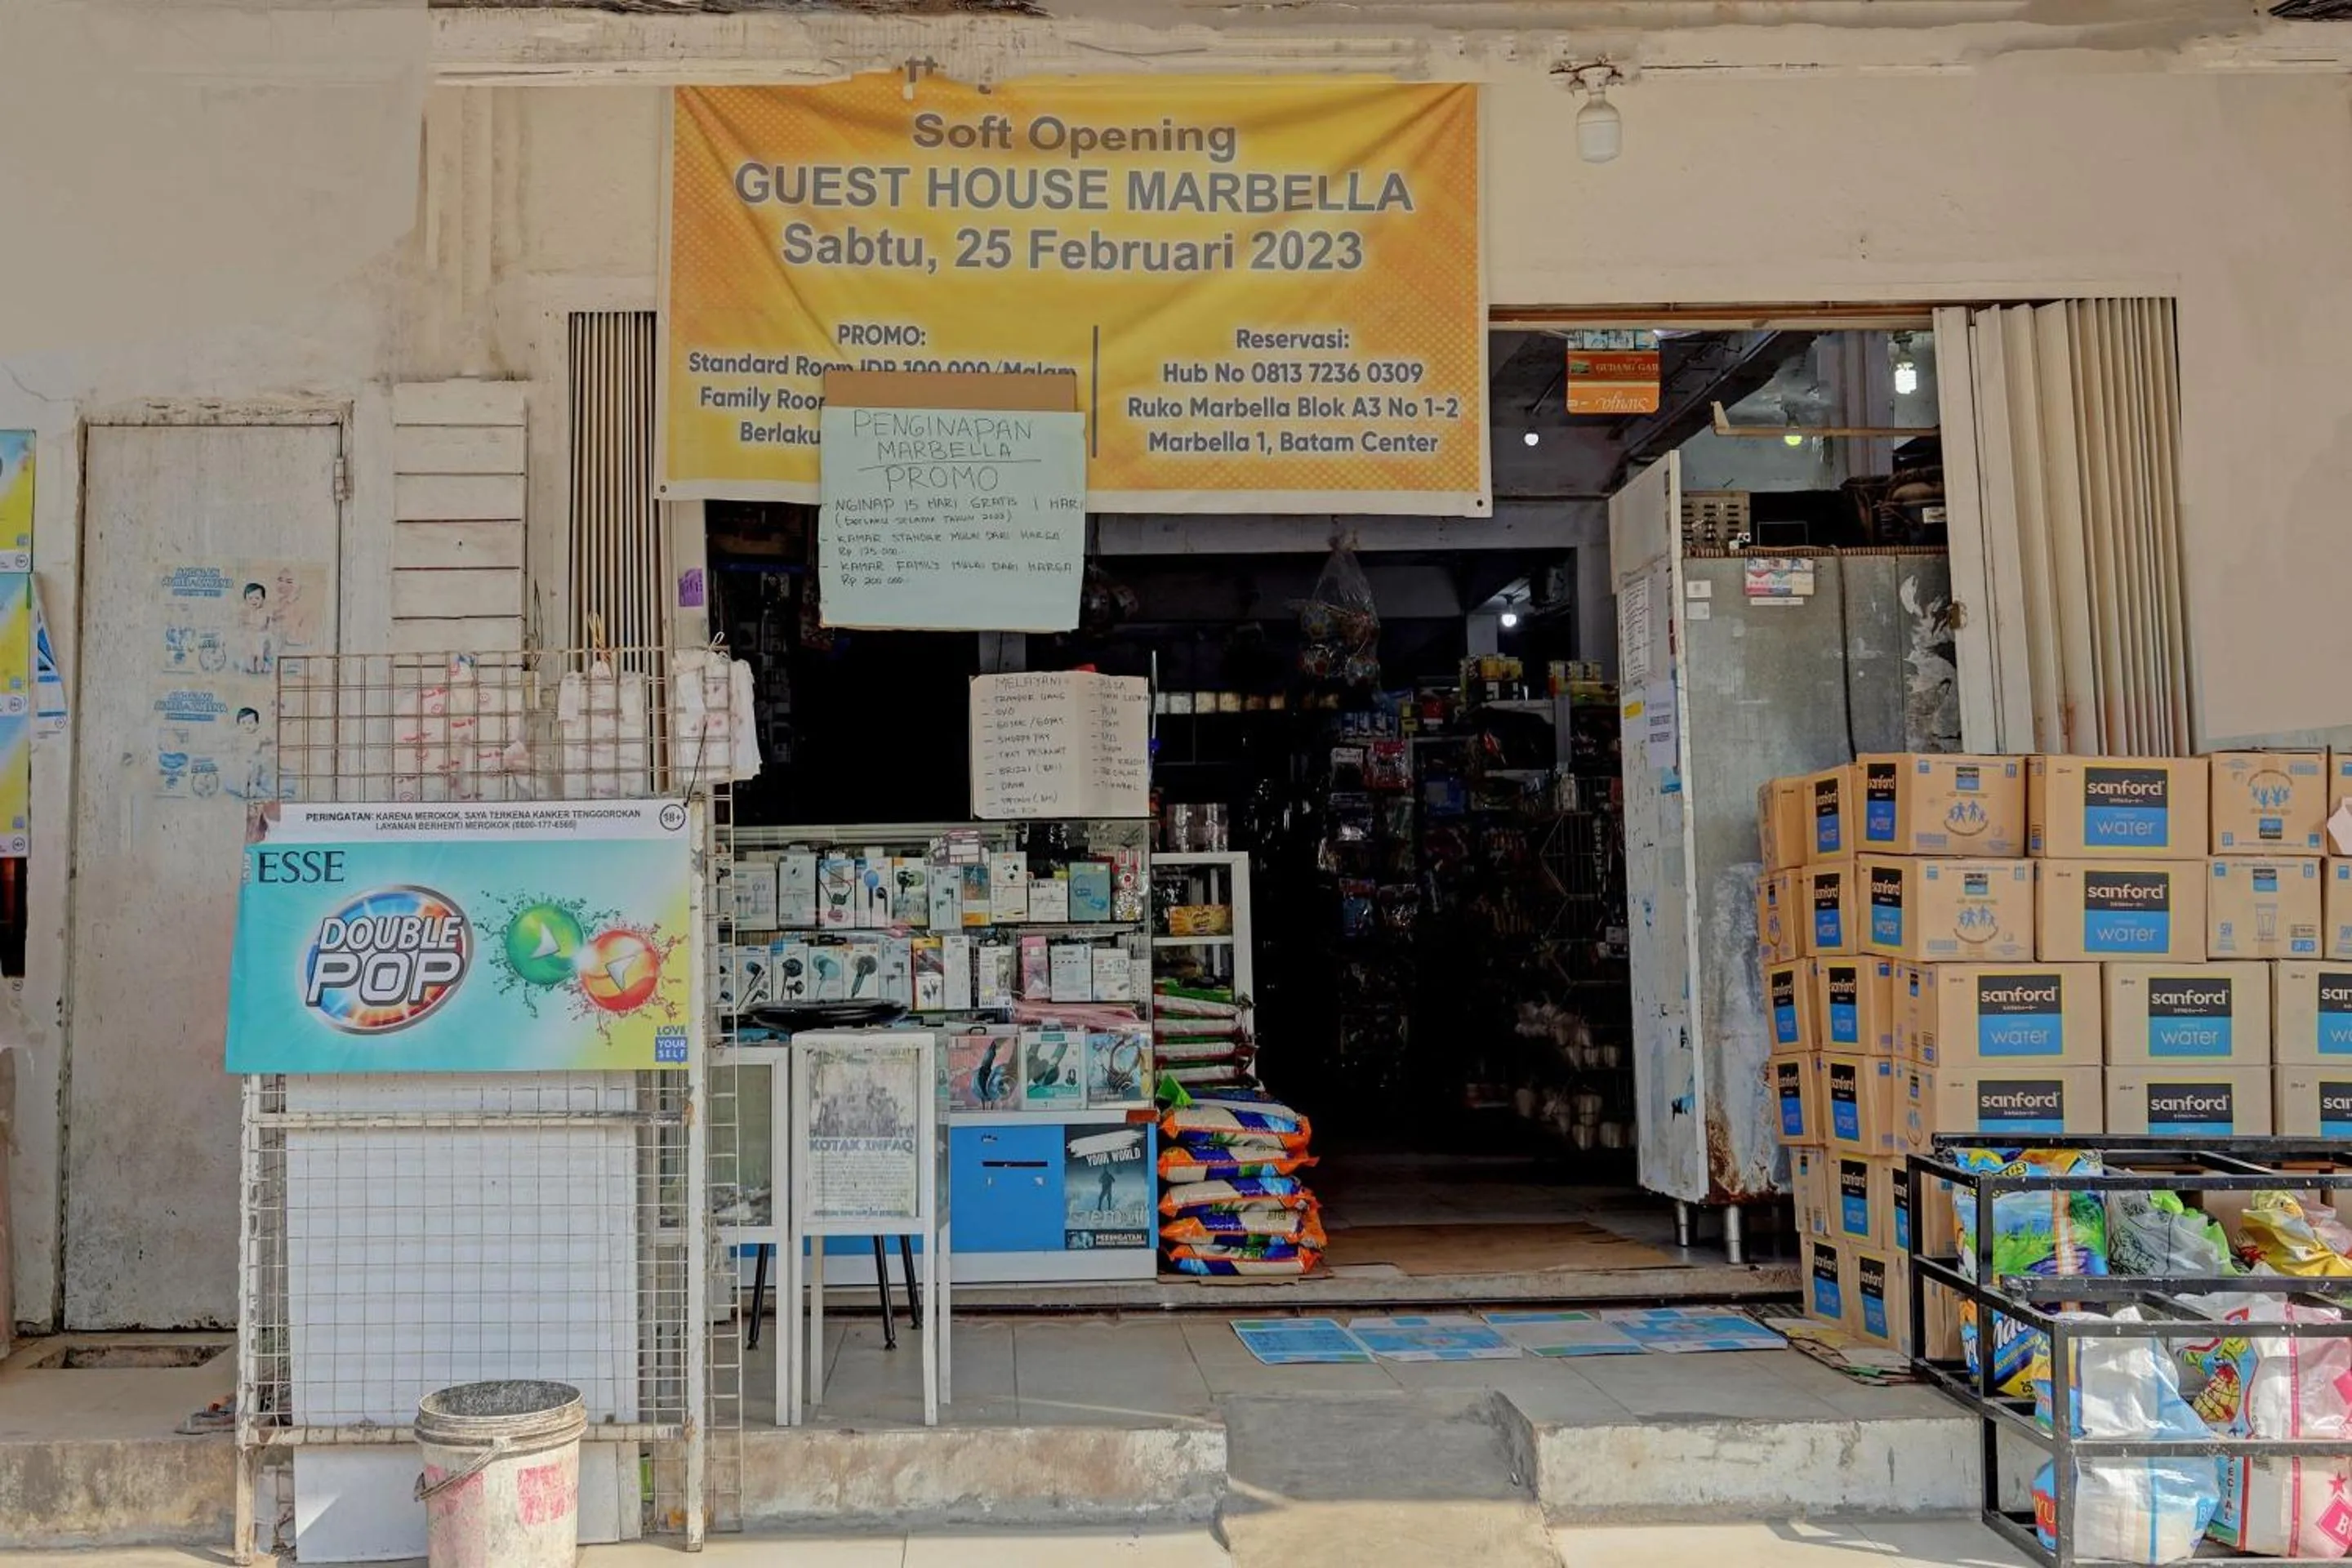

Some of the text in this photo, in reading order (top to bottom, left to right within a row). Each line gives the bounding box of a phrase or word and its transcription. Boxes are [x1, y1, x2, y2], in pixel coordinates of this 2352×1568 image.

[912, 113, 1236, 163] Soft Opening
[735, 162, 1413, 213] GUEST HOUSE MARBELLA
[782, 222, 1362, 274] Sabtu, 25 Februari 2023
[837, 324, 926, 346] PROMO:
[1236, 328, 1350, 349] Reservasi:
[689, 352, 789, 376] Standard
[1163, 363, 1423, 384] Hub No 0813 7236 0309
[700, 386, 771, 412] Family
[1128, 397, 1459, 417] Ruko Marbella Blok A3 No 1-2
[740, 421, 822, 445] Berlaku
[853, 408, 1033, 444] PENGINAPAN
[877, 440, 1012, 461] MARBELLA
[1148, 431, 1438, 454] Marbella 1, Batam Center
[884, 466, 1000, 492] PROMO
[835, 497, 895, 512] NGINAP
[905, 499, 919, 511] 15
[928, 497, 958, 510] HARI
[970, 497, 1018, 509] GRATIS
[2087, 779, 2163, 795] sanford
[376, 811, 412, 821] KARENA
[464, 810, 487, 820] SAYA
[532, 809, 570, 819] KANKER
[2096, 820, 2156, 836] water
[258, 850, 345, 884] ESSE
[1872, 879, 1901, 896] sanford
[2087, 884, 2163, 900] sanford
[318, 915, 464, 953] DOUBLE
[2097, 925, 2158, 942] water
[305, 950, 466, 1008] POP
[1980, 986, 2056, 1003] sanford
[2151, 988, 2227, 1005] sanford
[1989, 1030, 2050, 1045] water
[2160, 1030, 2219, 1045] water
[1980, 1091, 2057, 1108] sanford
[2150, 1095, 2228, 1111] sanford
[809, 1139, 860, 1152] KOTAK
